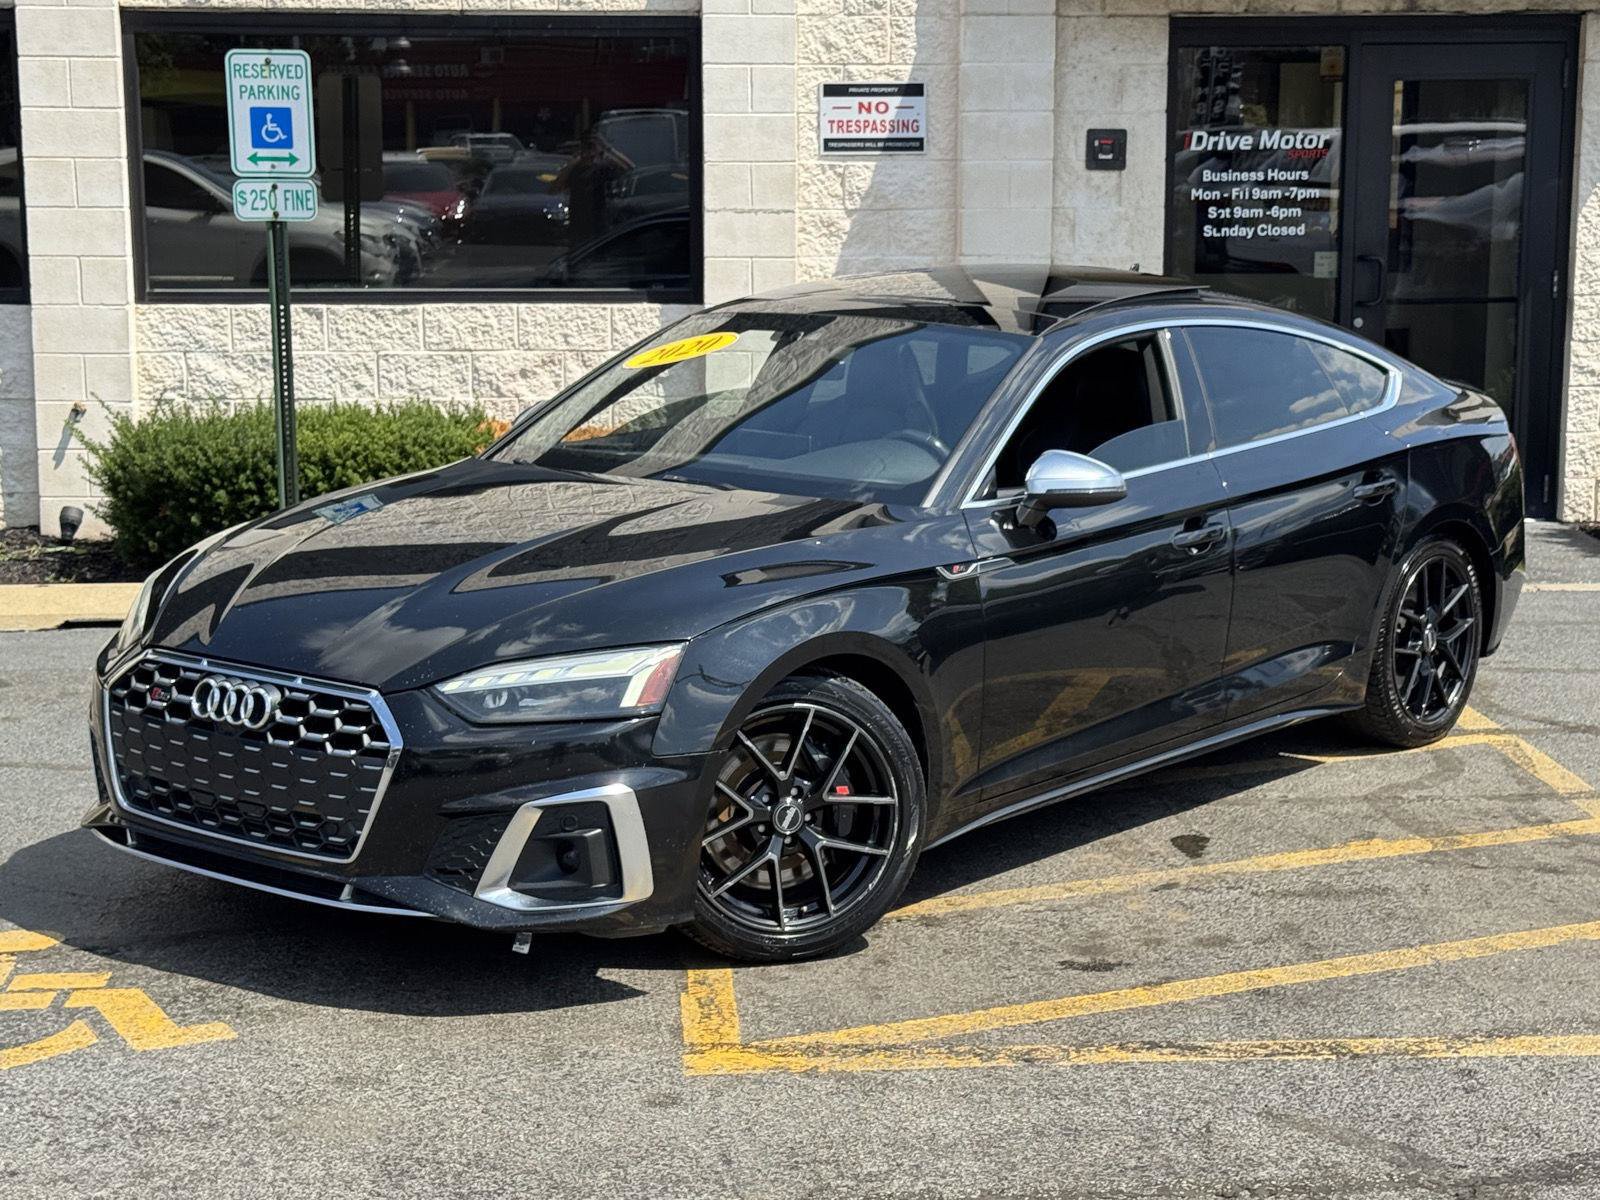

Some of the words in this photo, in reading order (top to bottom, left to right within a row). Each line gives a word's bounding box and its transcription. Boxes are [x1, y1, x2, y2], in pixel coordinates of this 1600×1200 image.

[233, 63, 304, 80] RESERVED
[239, 84, 301, 101] PARKING
[858, 101, 889, 115] NO
[828, 119, 920, 134] TRESPASSING
[1183, 129, 1254, 151] iDrive
[1259, 129, 1330, 150] Motor
[1287, 148, 1329, 160] SPORTS
[1202, 169, 1265, 182] Business
[1267, 168, 1309, 181] Hours
[237, 189, 278, 212] $250
[284, 189, 314, 212] FINE
[1190, 187, 1220, 201] Mon
[1251, 187, 1282, 200] 9am
[1233, 206, 1263, 219] 9am
[1257, 223, 1306, 236] Closed
[639, 335, 723, 365] 2020
